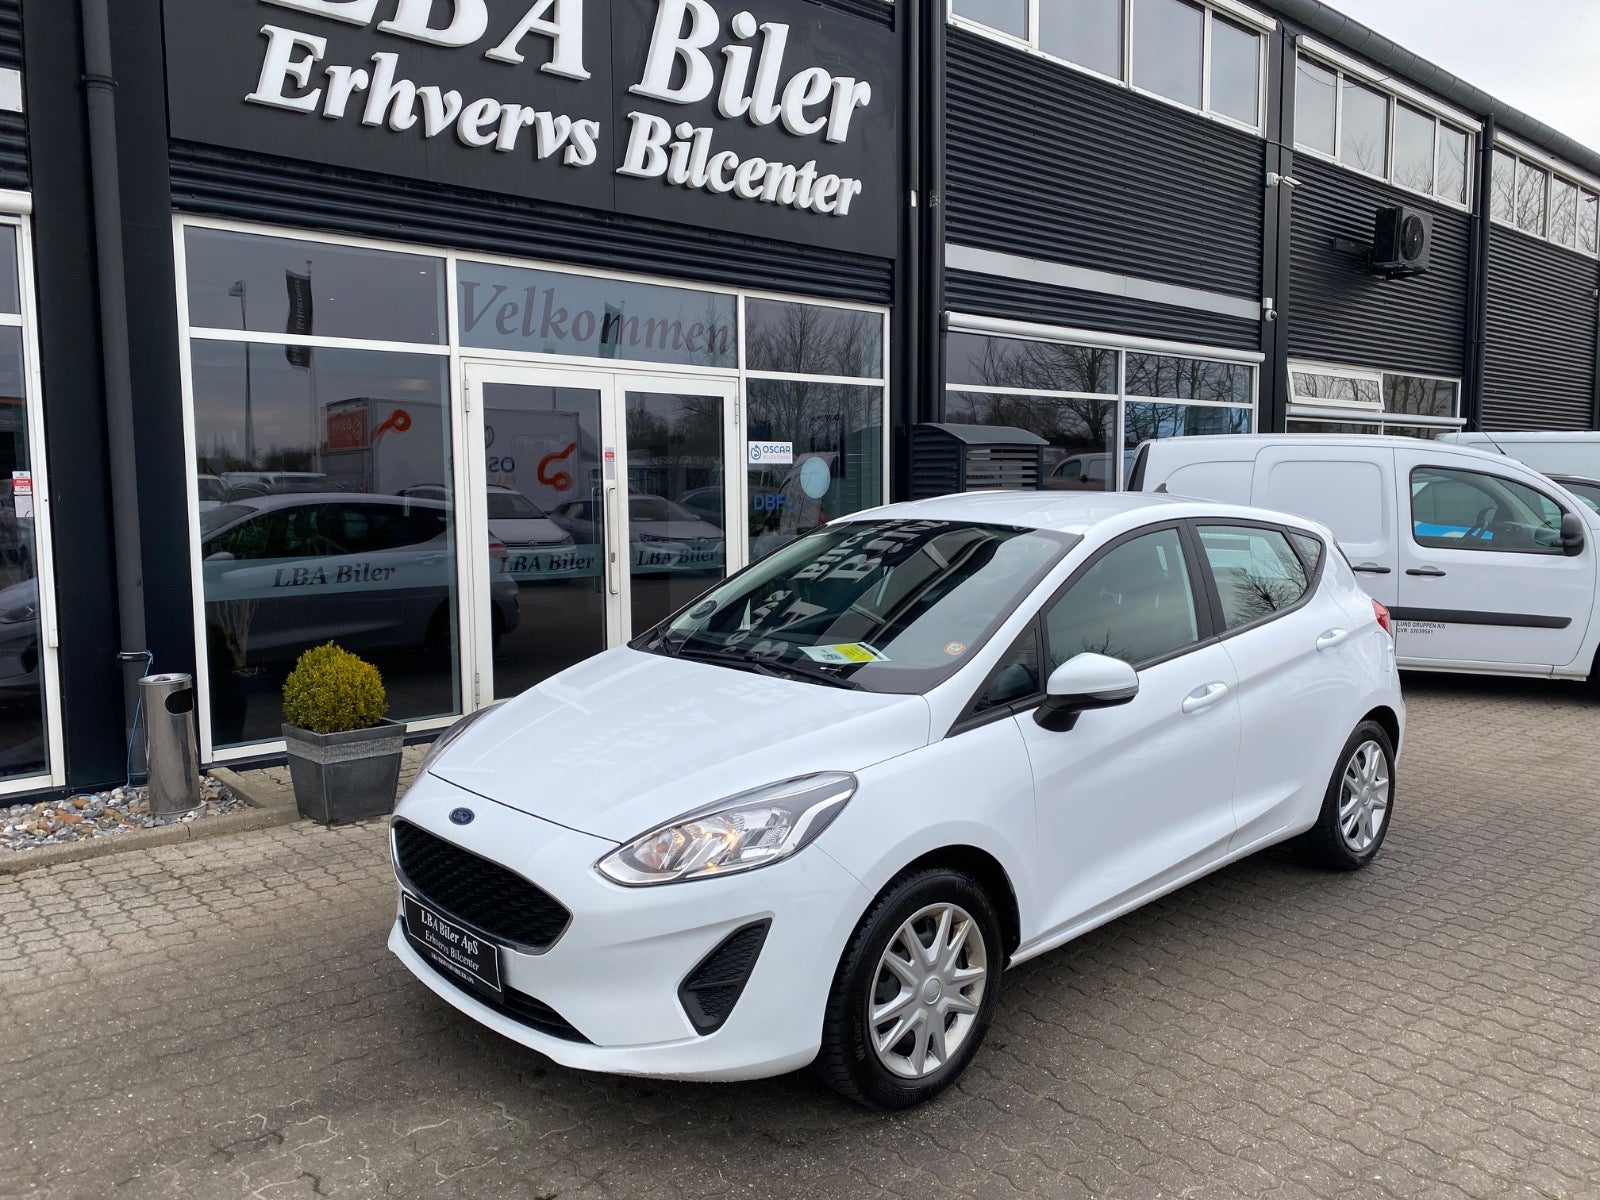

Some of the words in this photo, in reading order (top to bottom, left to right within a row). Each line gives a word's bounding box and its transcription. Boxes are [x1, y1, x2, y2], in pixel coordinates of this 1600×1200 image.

[628, 0, 871, 143] Biler
[245, 24, 600, 167] Erhvervs
[616, 111, 862, 216] Bilcenter
[459, 281, 728, 354] Velkommen
[762, 445, 791, 454] OSCAR
[498, 556, 542, 573] LBA
[549, 552, 595, 571] Biler
[636, 550, 673, 566] LBA
[677, 546, 717, 564] Biler
[272, 565, 328, 587] LBA
[335, 562, 396, 584] Biler
[421, 910, 438, 931] LBA
[439, 921, 460, 943] Biler
[461, 935, 479, 955] ApS
[450, 947, 479, 971] Bilcenter
